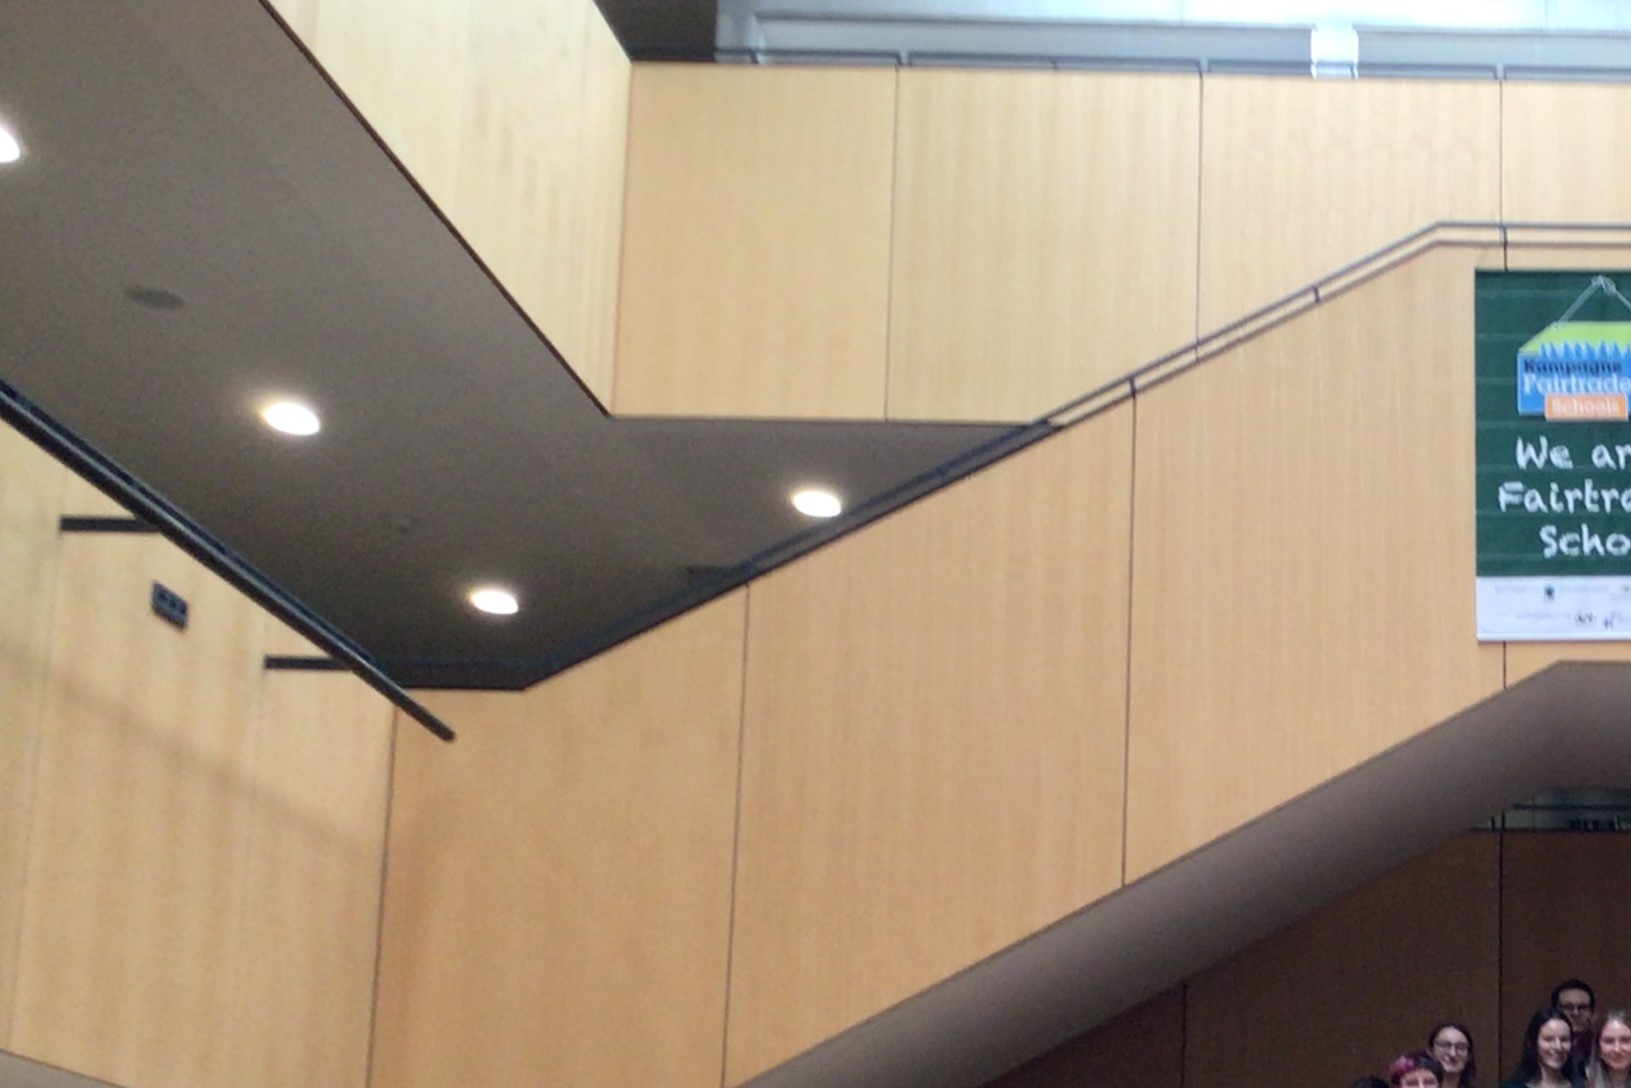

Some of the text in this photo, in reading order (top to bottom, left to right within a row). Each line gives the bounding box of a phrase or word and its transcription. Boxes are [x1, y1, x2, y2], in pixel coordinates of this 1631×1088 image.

[1523, 360, 1622, 375] Kampagne
[1552, 397, 1620, 415] Schools
[1515, 435, 1574, 471] We
